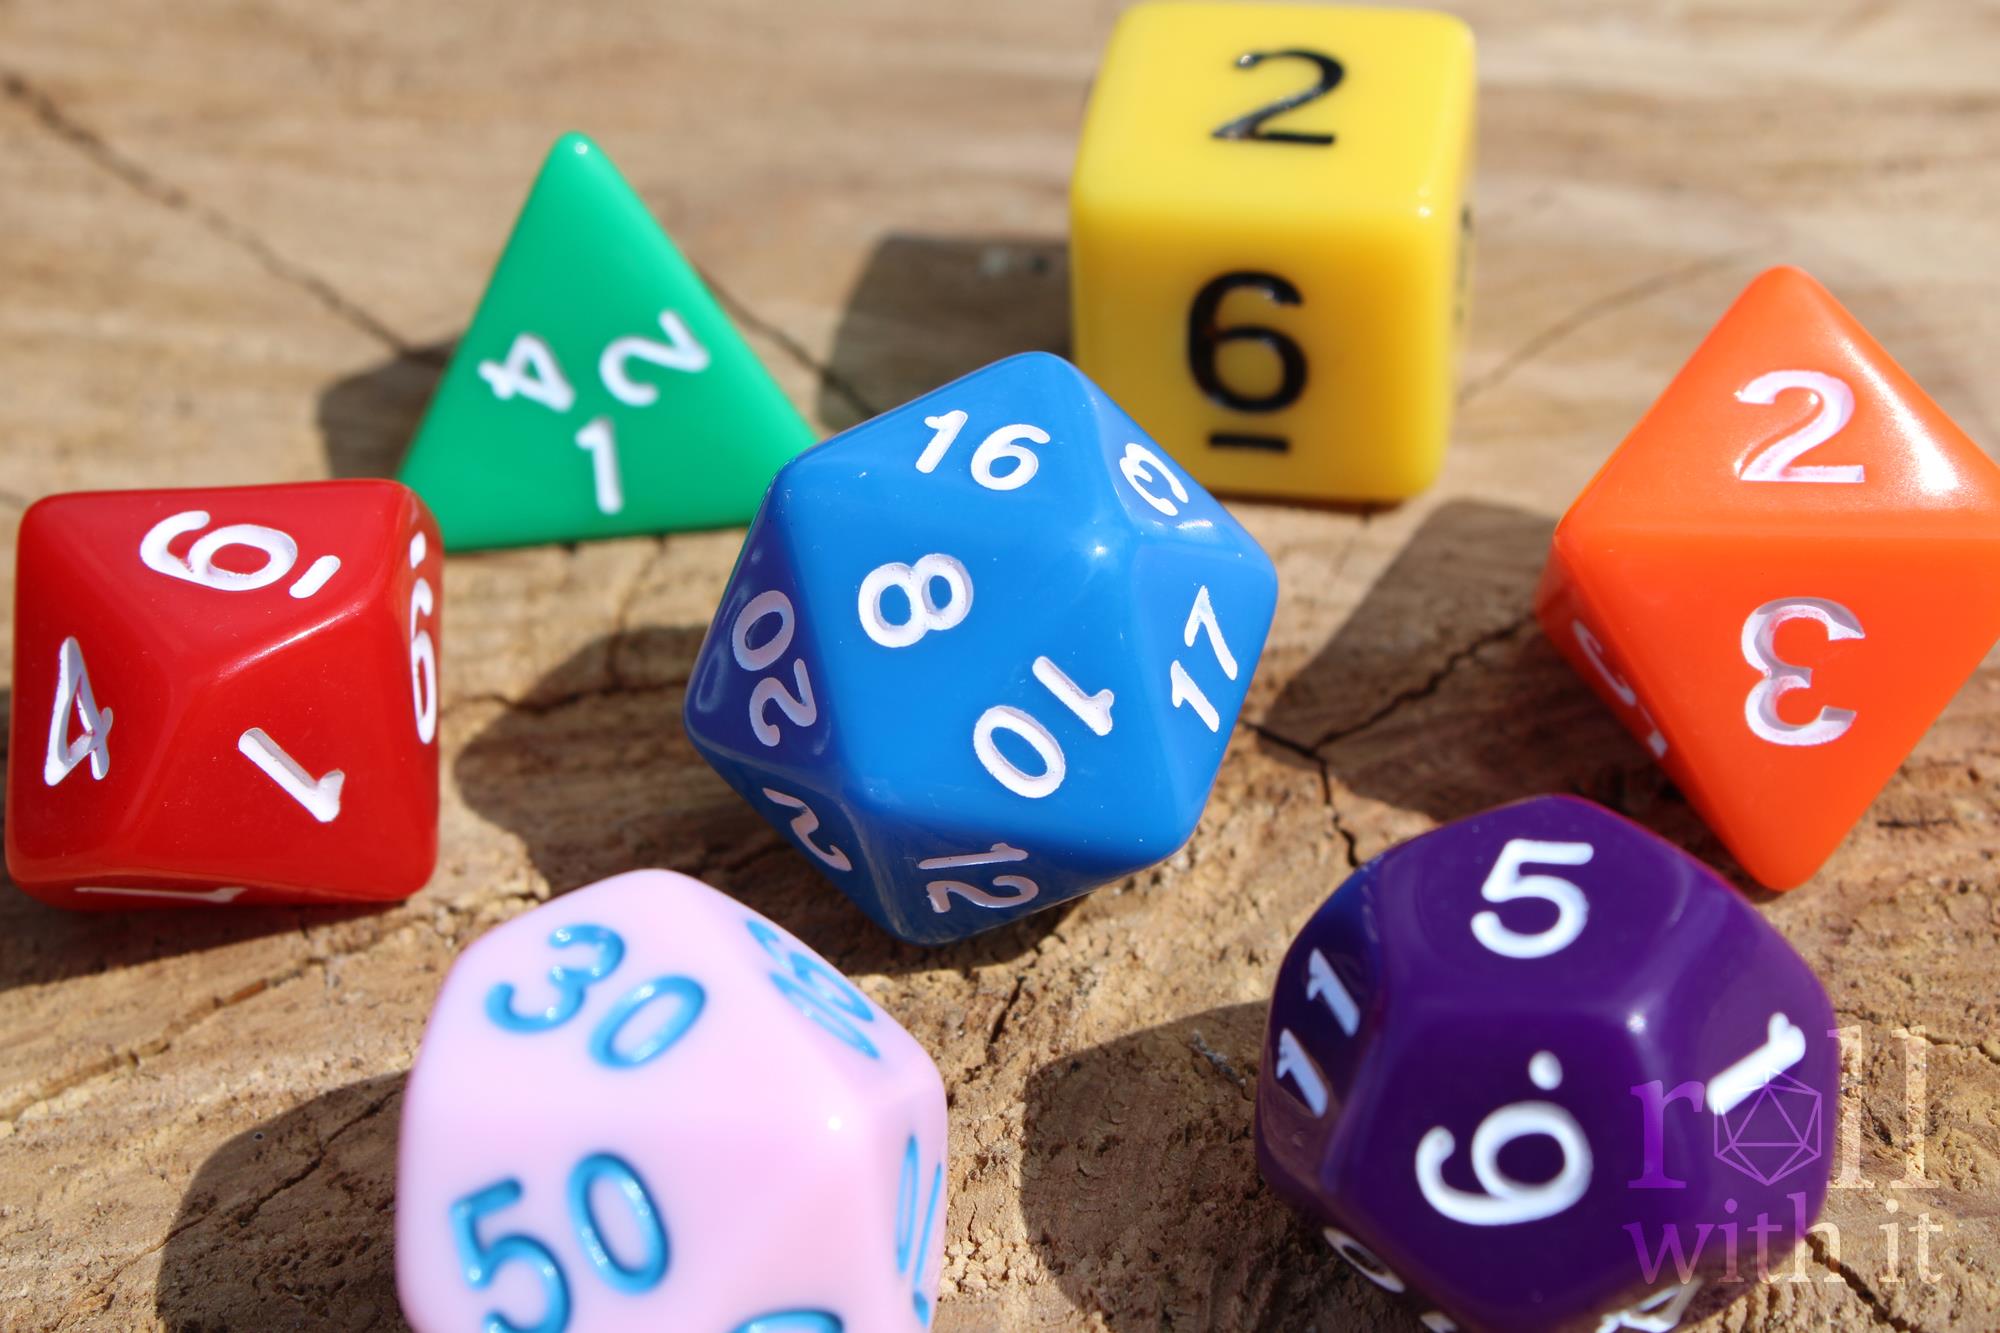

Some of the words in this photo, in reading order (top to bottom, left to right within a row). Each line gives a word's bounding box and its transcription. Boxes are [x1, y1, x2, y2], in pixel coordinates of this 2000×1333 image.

[1210, 49, 1346, 145] 2
[477, 333, 575, 412] 4
[599, 309, 710, 406] 2
[575, 417, 622, 514] 1
[915, 410, 1050, 490] 16
[1119, 443, 1188, 516] 3
[1734, 369, 1865, 483] 2
[858, 553, 974, 648] 8
[43, 636, 113, 786] 4
[732, 590, 817, 747] 20
[1171, 585, 1237, 732] 17
[1741, 597, 1865, 746] 3
[238, 727, 345, 823] 1
[973, 656, 1114, 798] 10
[918, 842, 1039, 913] 12
[1471, 839, 1594, 959] 5
[484, 924, 706, 1071] 30
[1277, 948, 1360, 1117] 11
[1706, 1012, 1806, 1115] 1
[448, 1151, 669, 1333] 50
